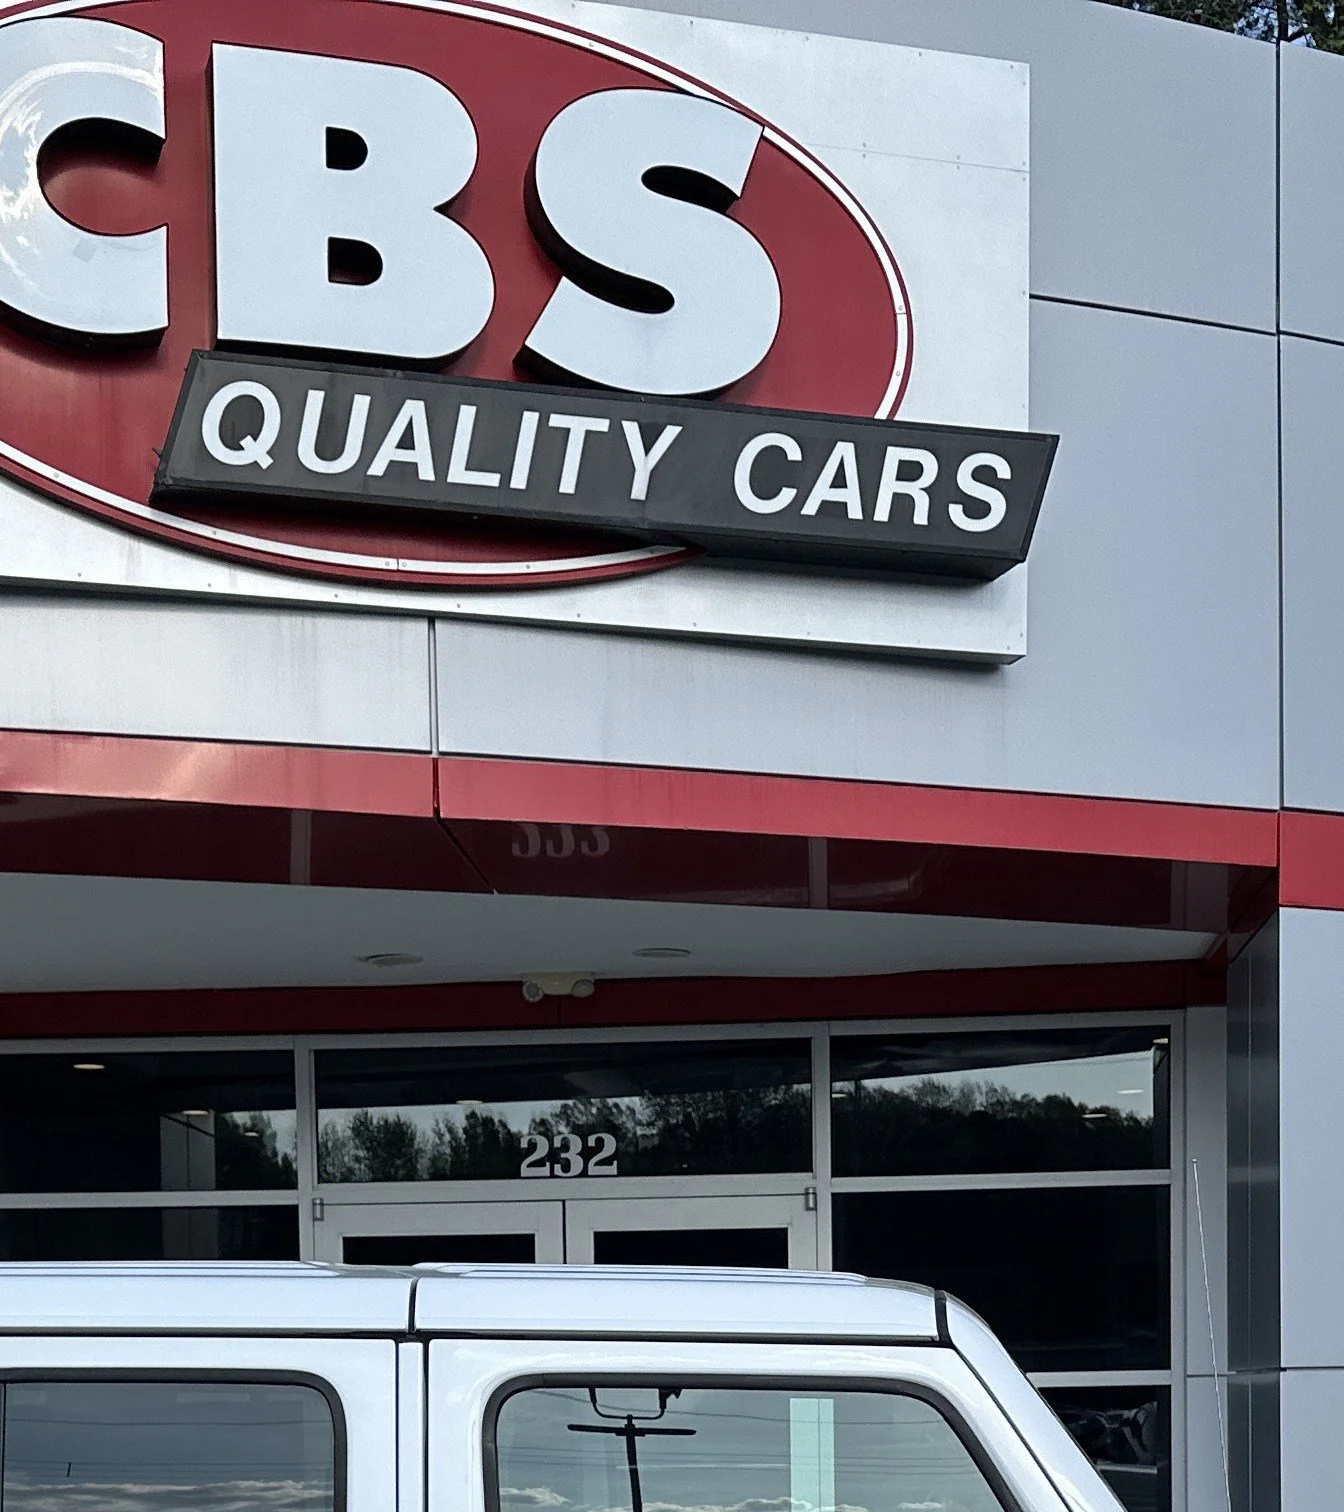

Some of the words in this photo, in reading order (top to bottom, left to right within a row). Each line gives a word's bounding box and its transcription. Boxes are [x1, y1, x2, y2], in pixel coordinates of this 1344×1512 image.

[201, 379, 682, 502] QUALITY
[733, 431, 1013, 535] CARS
[520, 1132, 618, 1177] 232
